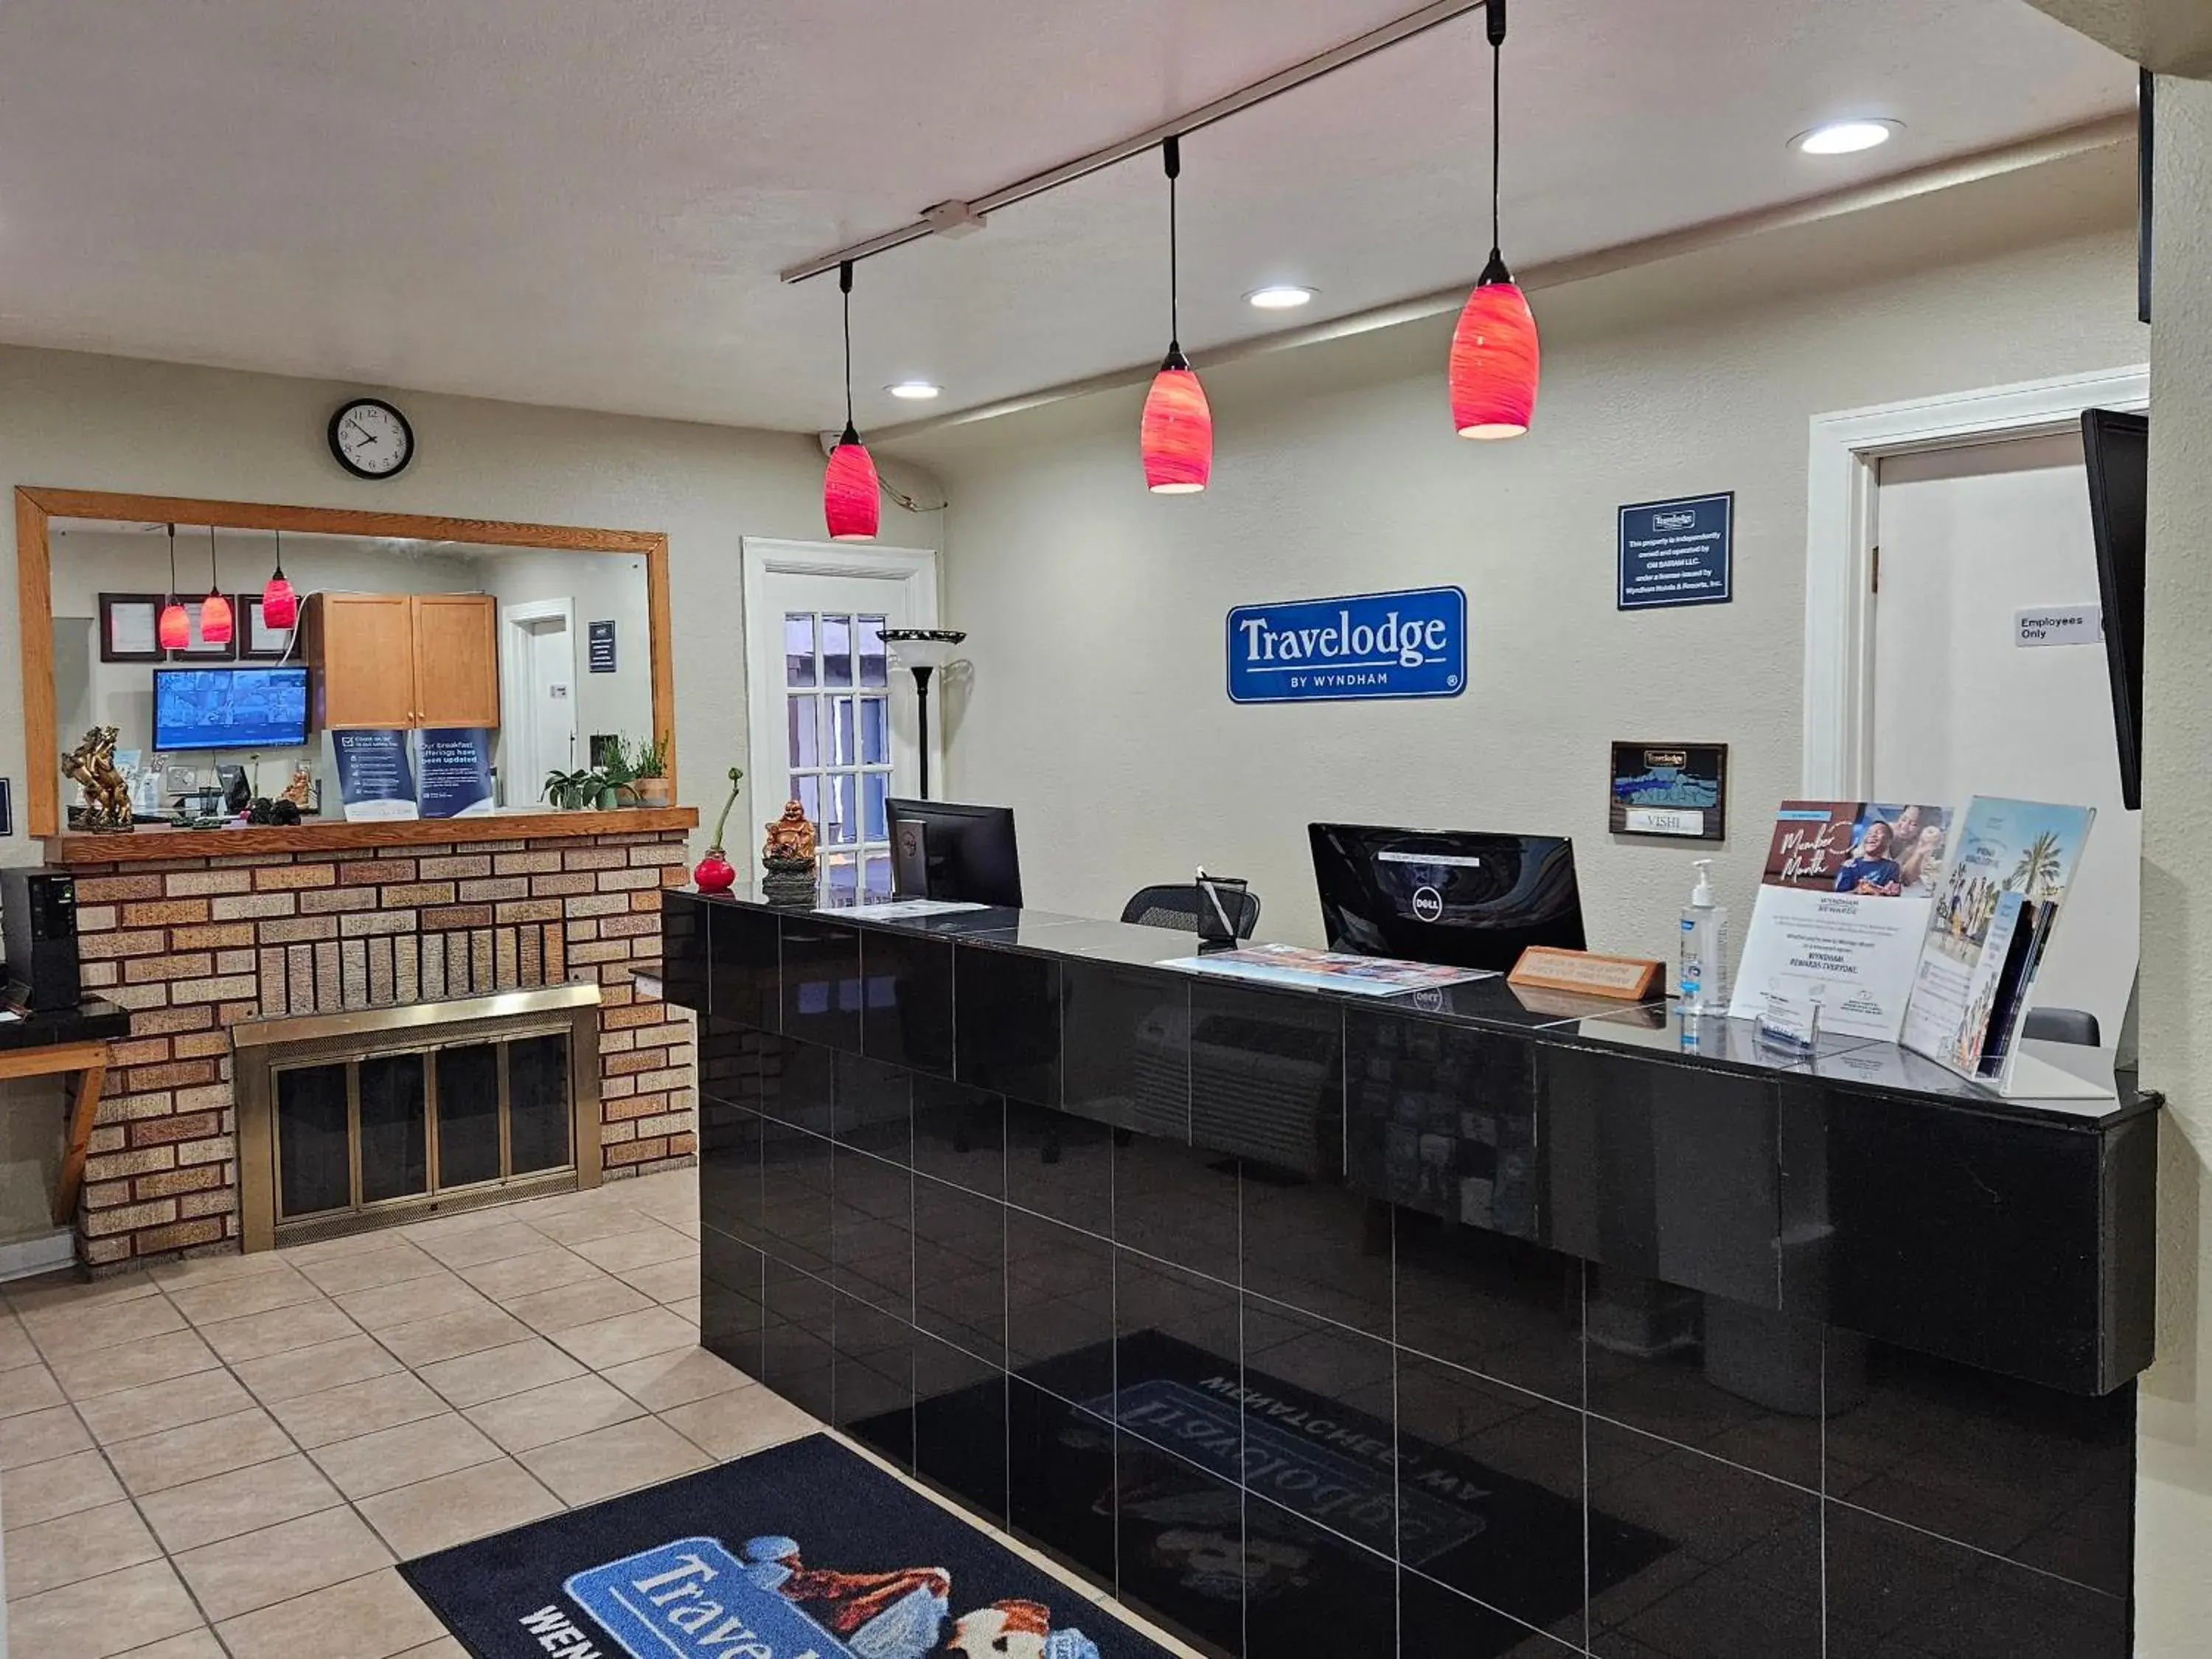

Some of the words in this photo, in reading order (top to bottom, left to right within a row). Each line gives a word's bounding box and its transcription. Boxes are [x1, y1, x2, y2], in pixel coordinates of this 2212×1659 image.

[2021, 616, 2083, 627] Employees
[1239, 611, 1447, 667] Travelodge
[2021, 629, 2047, 639] Only
[1290, 677, 1307, 688] BY
[1314, 672, 1388, 686] WYNDHAM
[1648, 815, 1680, 827] VISHI
[1780, 822, 1835, 856] Member
[1781, 849, 1829, 883] Month
[1416, 898, 1439, 909] DELL
[633, 1554, 819, 1659] Trave
